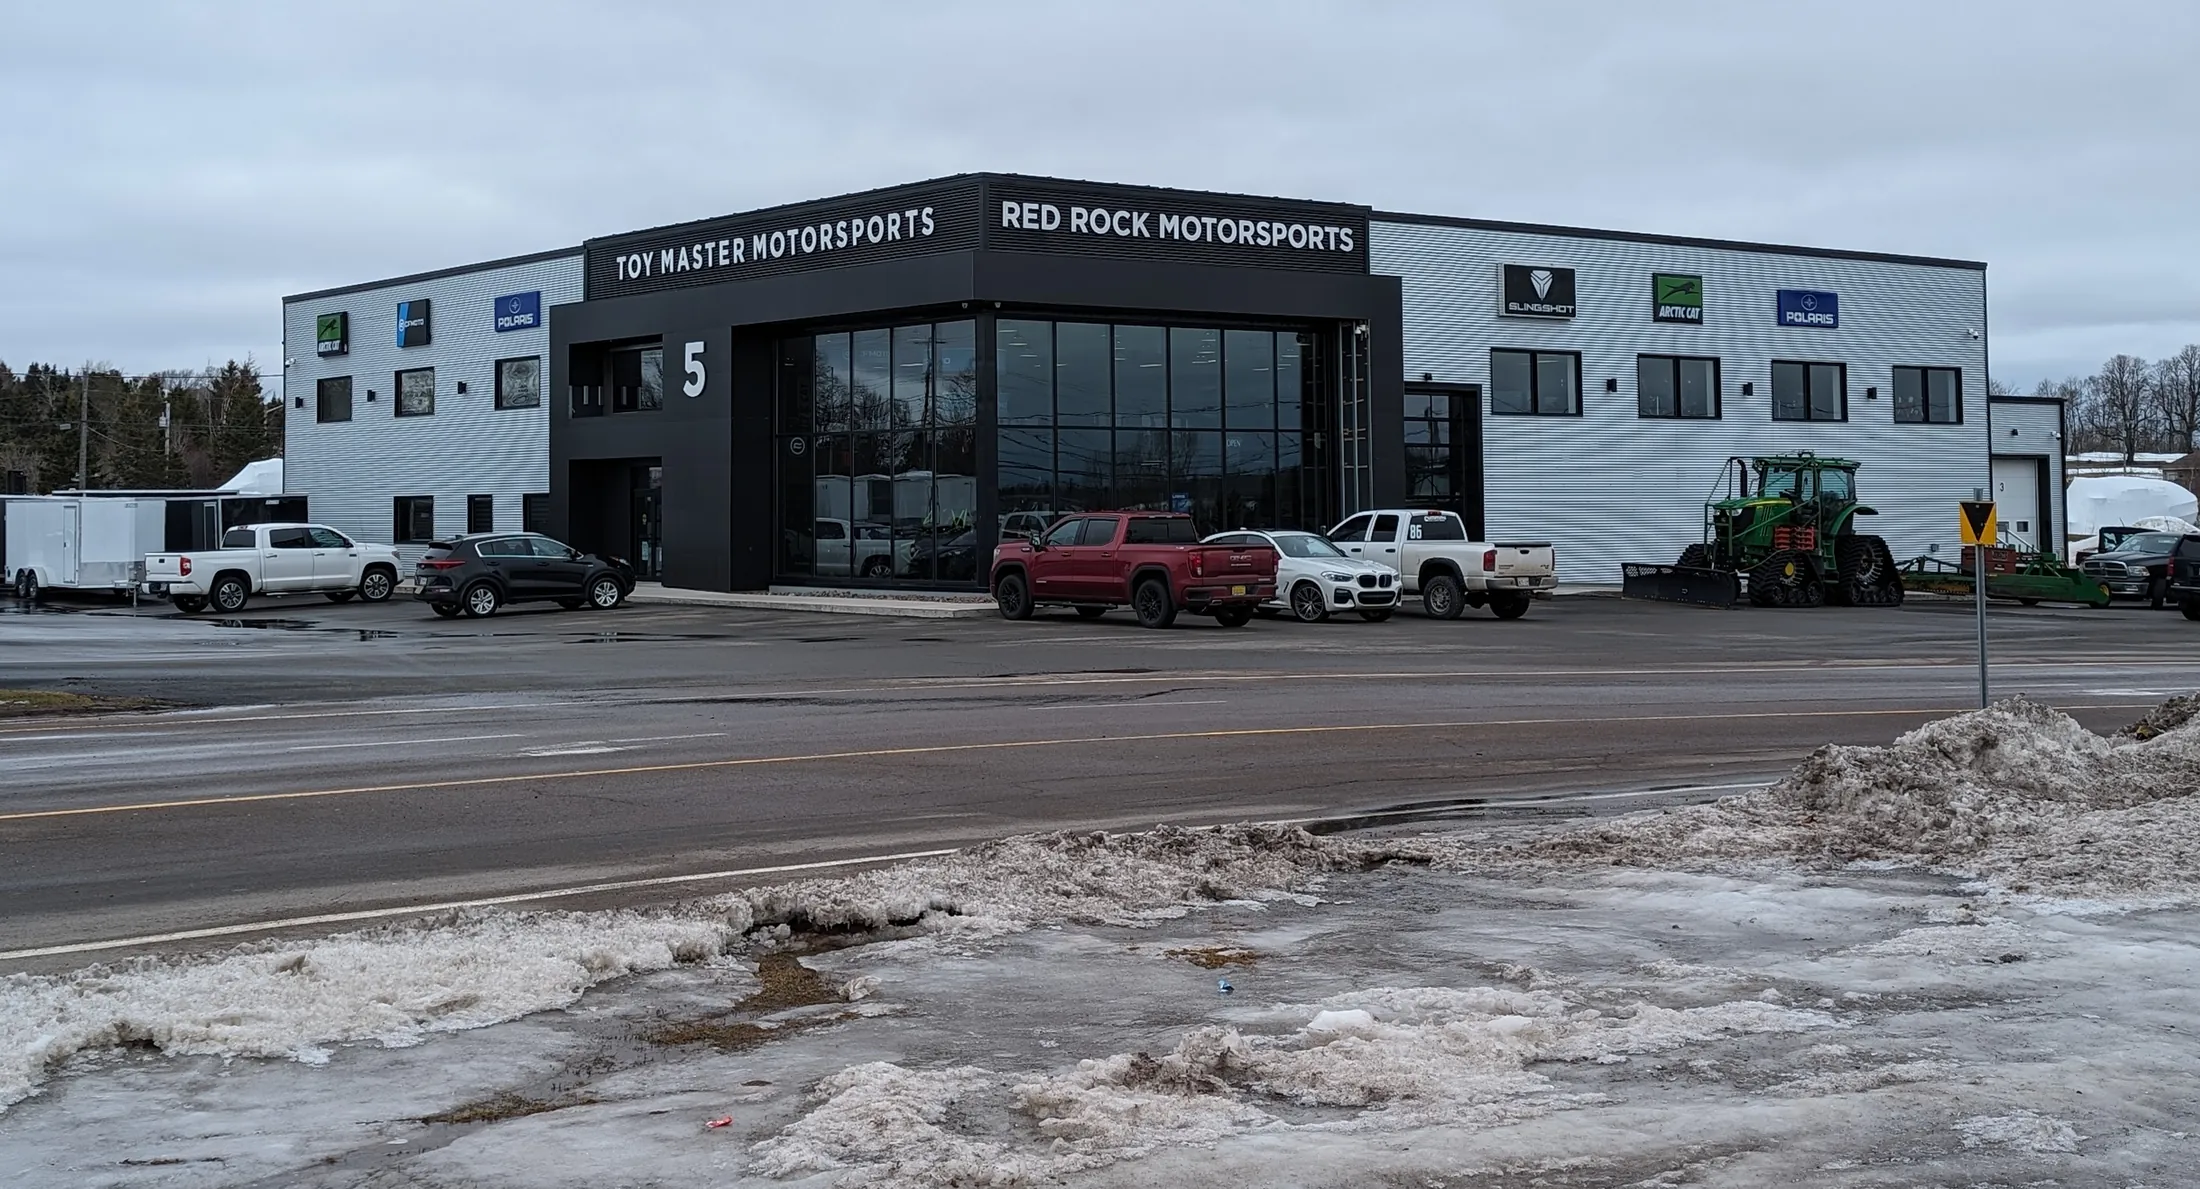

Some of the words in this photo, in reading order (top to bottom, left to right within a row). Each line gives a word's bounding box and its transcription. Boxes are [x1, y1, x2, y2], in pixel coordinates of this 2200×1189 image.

[1002, 201, 1061, 231] RED
[1071, 207, 1151, 238] ROCK
[1159, 213, 1354, 252] MOTORSPORTS
[616, 251, 654, 281] TOY
[661, 237, 745, 274] MASTER
[753, 207, 935, 260] MOTORSPORTS
[1508, 302, 1575, 313] SLINGSHOT
[1659, 305, 1686, 318] ARCTIC
[1686, 307, 1701, 320] CAT
[498, 313, 534, 328] POLARIS
[1786, 311, 1834, 325] POLARIS
[682, 341, 706, 398] 5
[1999, 482, 2005, 492] 3
[1409, 524, 1423, 539] 86
